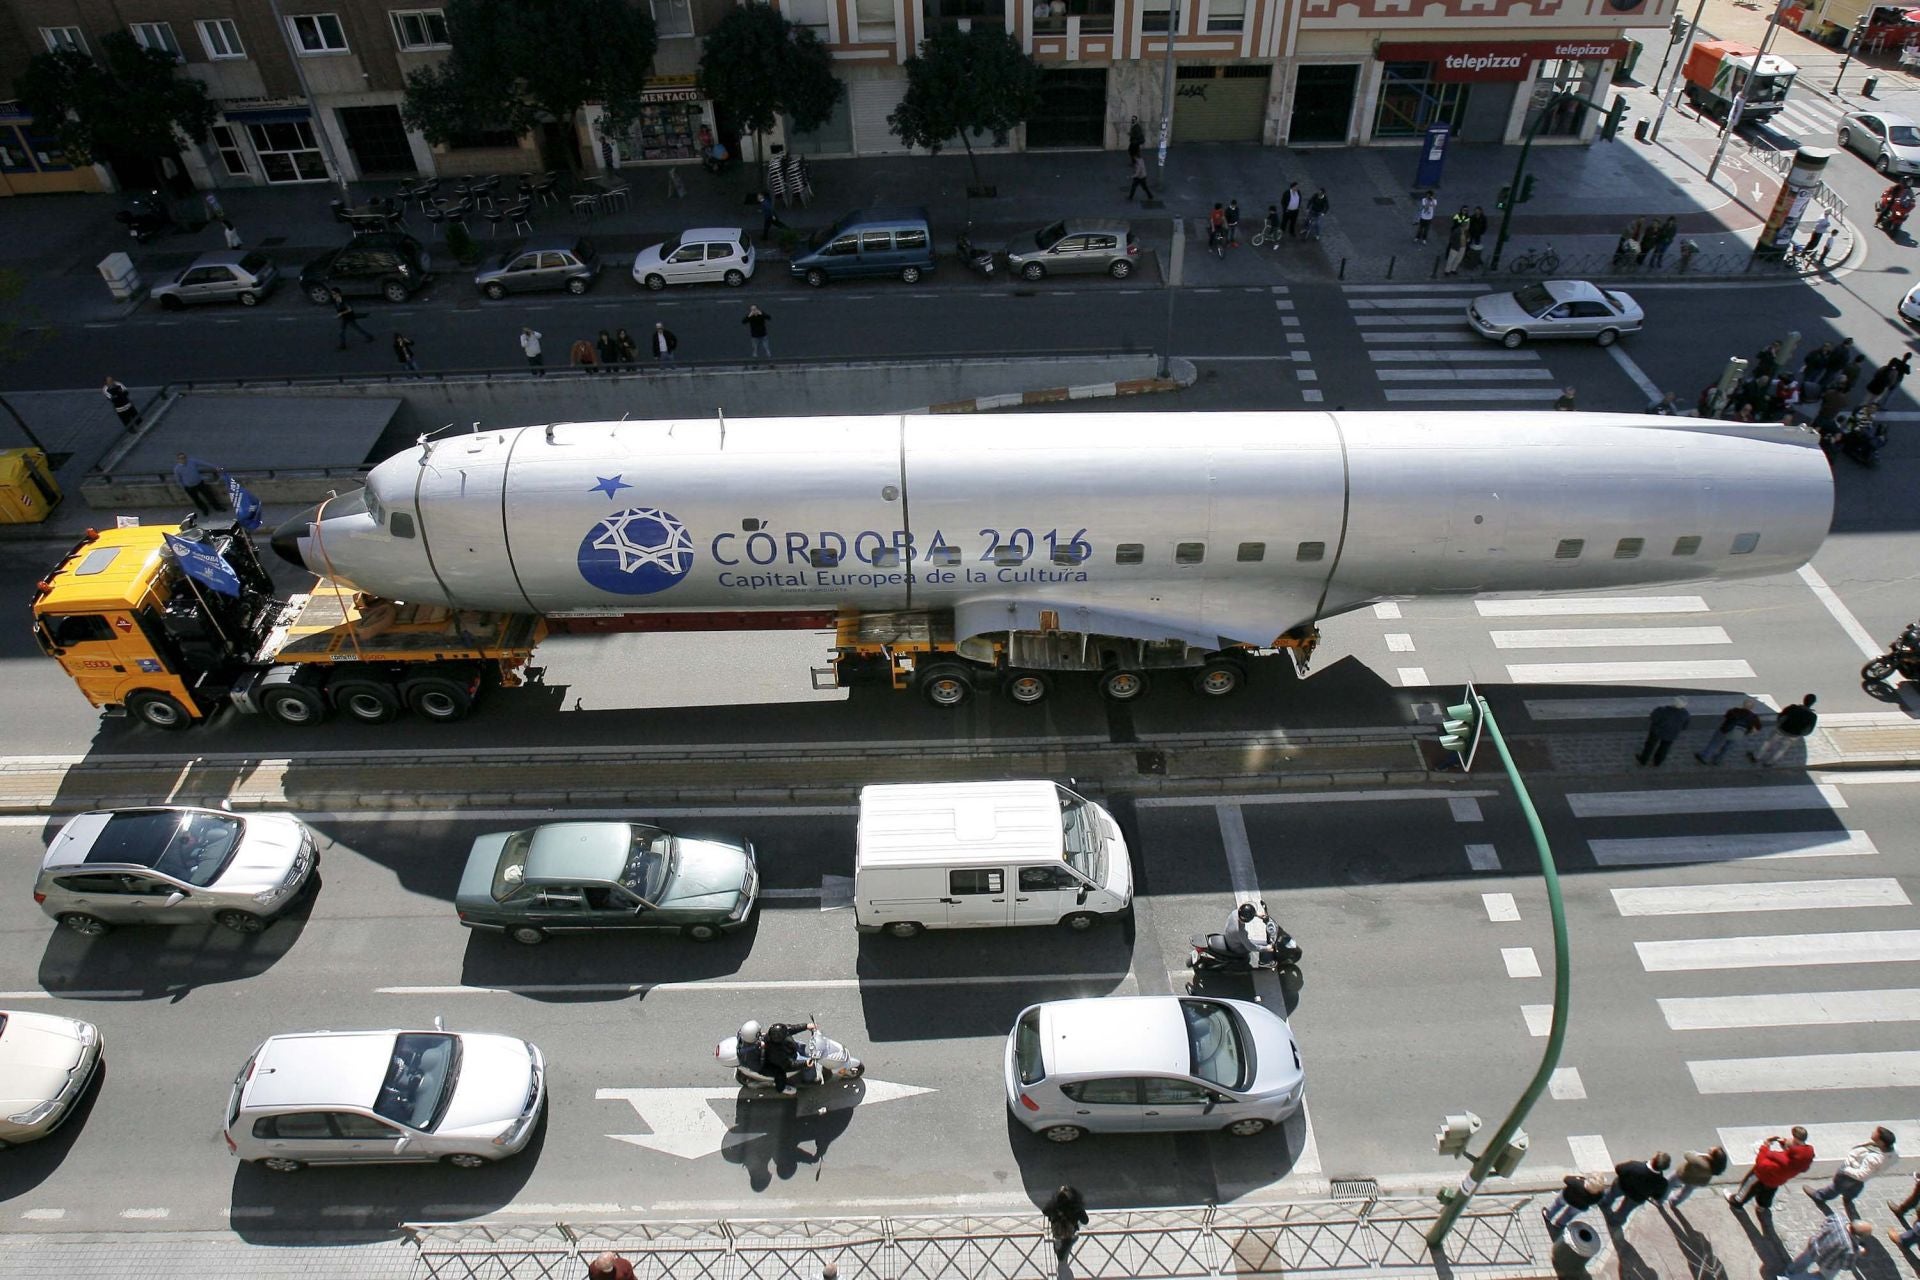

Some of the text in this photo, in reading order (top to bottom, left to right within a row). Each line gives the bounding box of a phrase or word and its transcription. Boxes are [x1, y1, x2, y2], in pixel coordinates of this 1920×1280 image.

[1555, 43, 1610, 57] telepizza
[1445, 53, 1521, 72] telepizza
[640, 92, 699, 103] MENTACIO
[711, 521, 1092, 567] CÓRDOBA 2016
[719, 568, 1088, 590] Capital Europea de la Cultura
